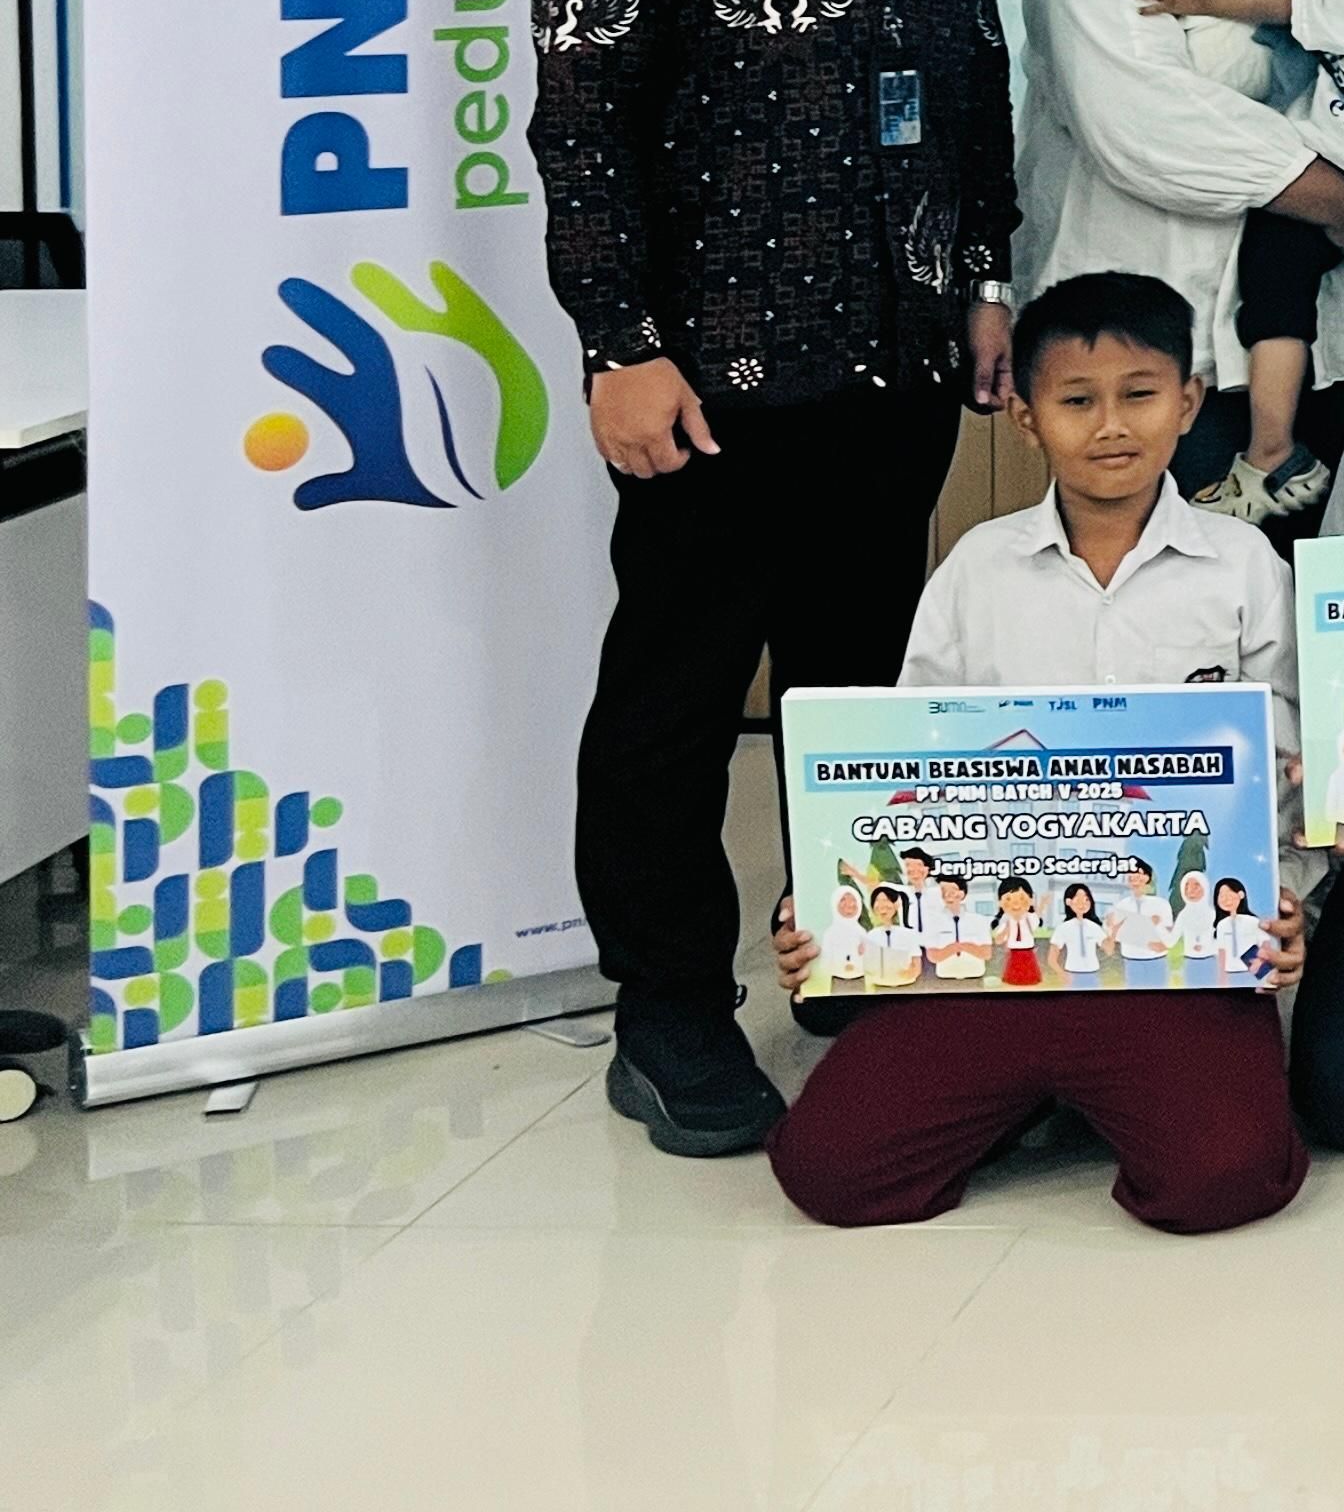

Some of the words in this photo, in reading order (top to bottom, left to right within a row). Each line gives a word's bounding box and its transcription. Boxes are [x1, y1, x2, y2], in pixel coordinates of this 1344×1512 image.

[1049, 698, 1078, 711] TJSL
[1092, 697, 1127, 709] PNM
[817, 761, 920, 783] BANTUAN
[928, 758, 1041, 780] BEASISWA
[1049, 756, 1109, 778] ANAK
[1117, 752, 1222, 775] NASABAH
[915, 784, 940, 803] PT
[945, 784, 986, 803] PNM
[992, 783, 1052, 802] BATCH
[1058, 783, 1072, 801] V
[1077, 783, 1123, 800] 2025
[852, 813, 986, 841] CABANG
[994, 810, 1209, 839] YOGYAKARTA
[930, 858, 1010, 881] Jenjang
[1013, 857, 1041, 876] SD
[1043, 856, 1138, 877] Sederajat
